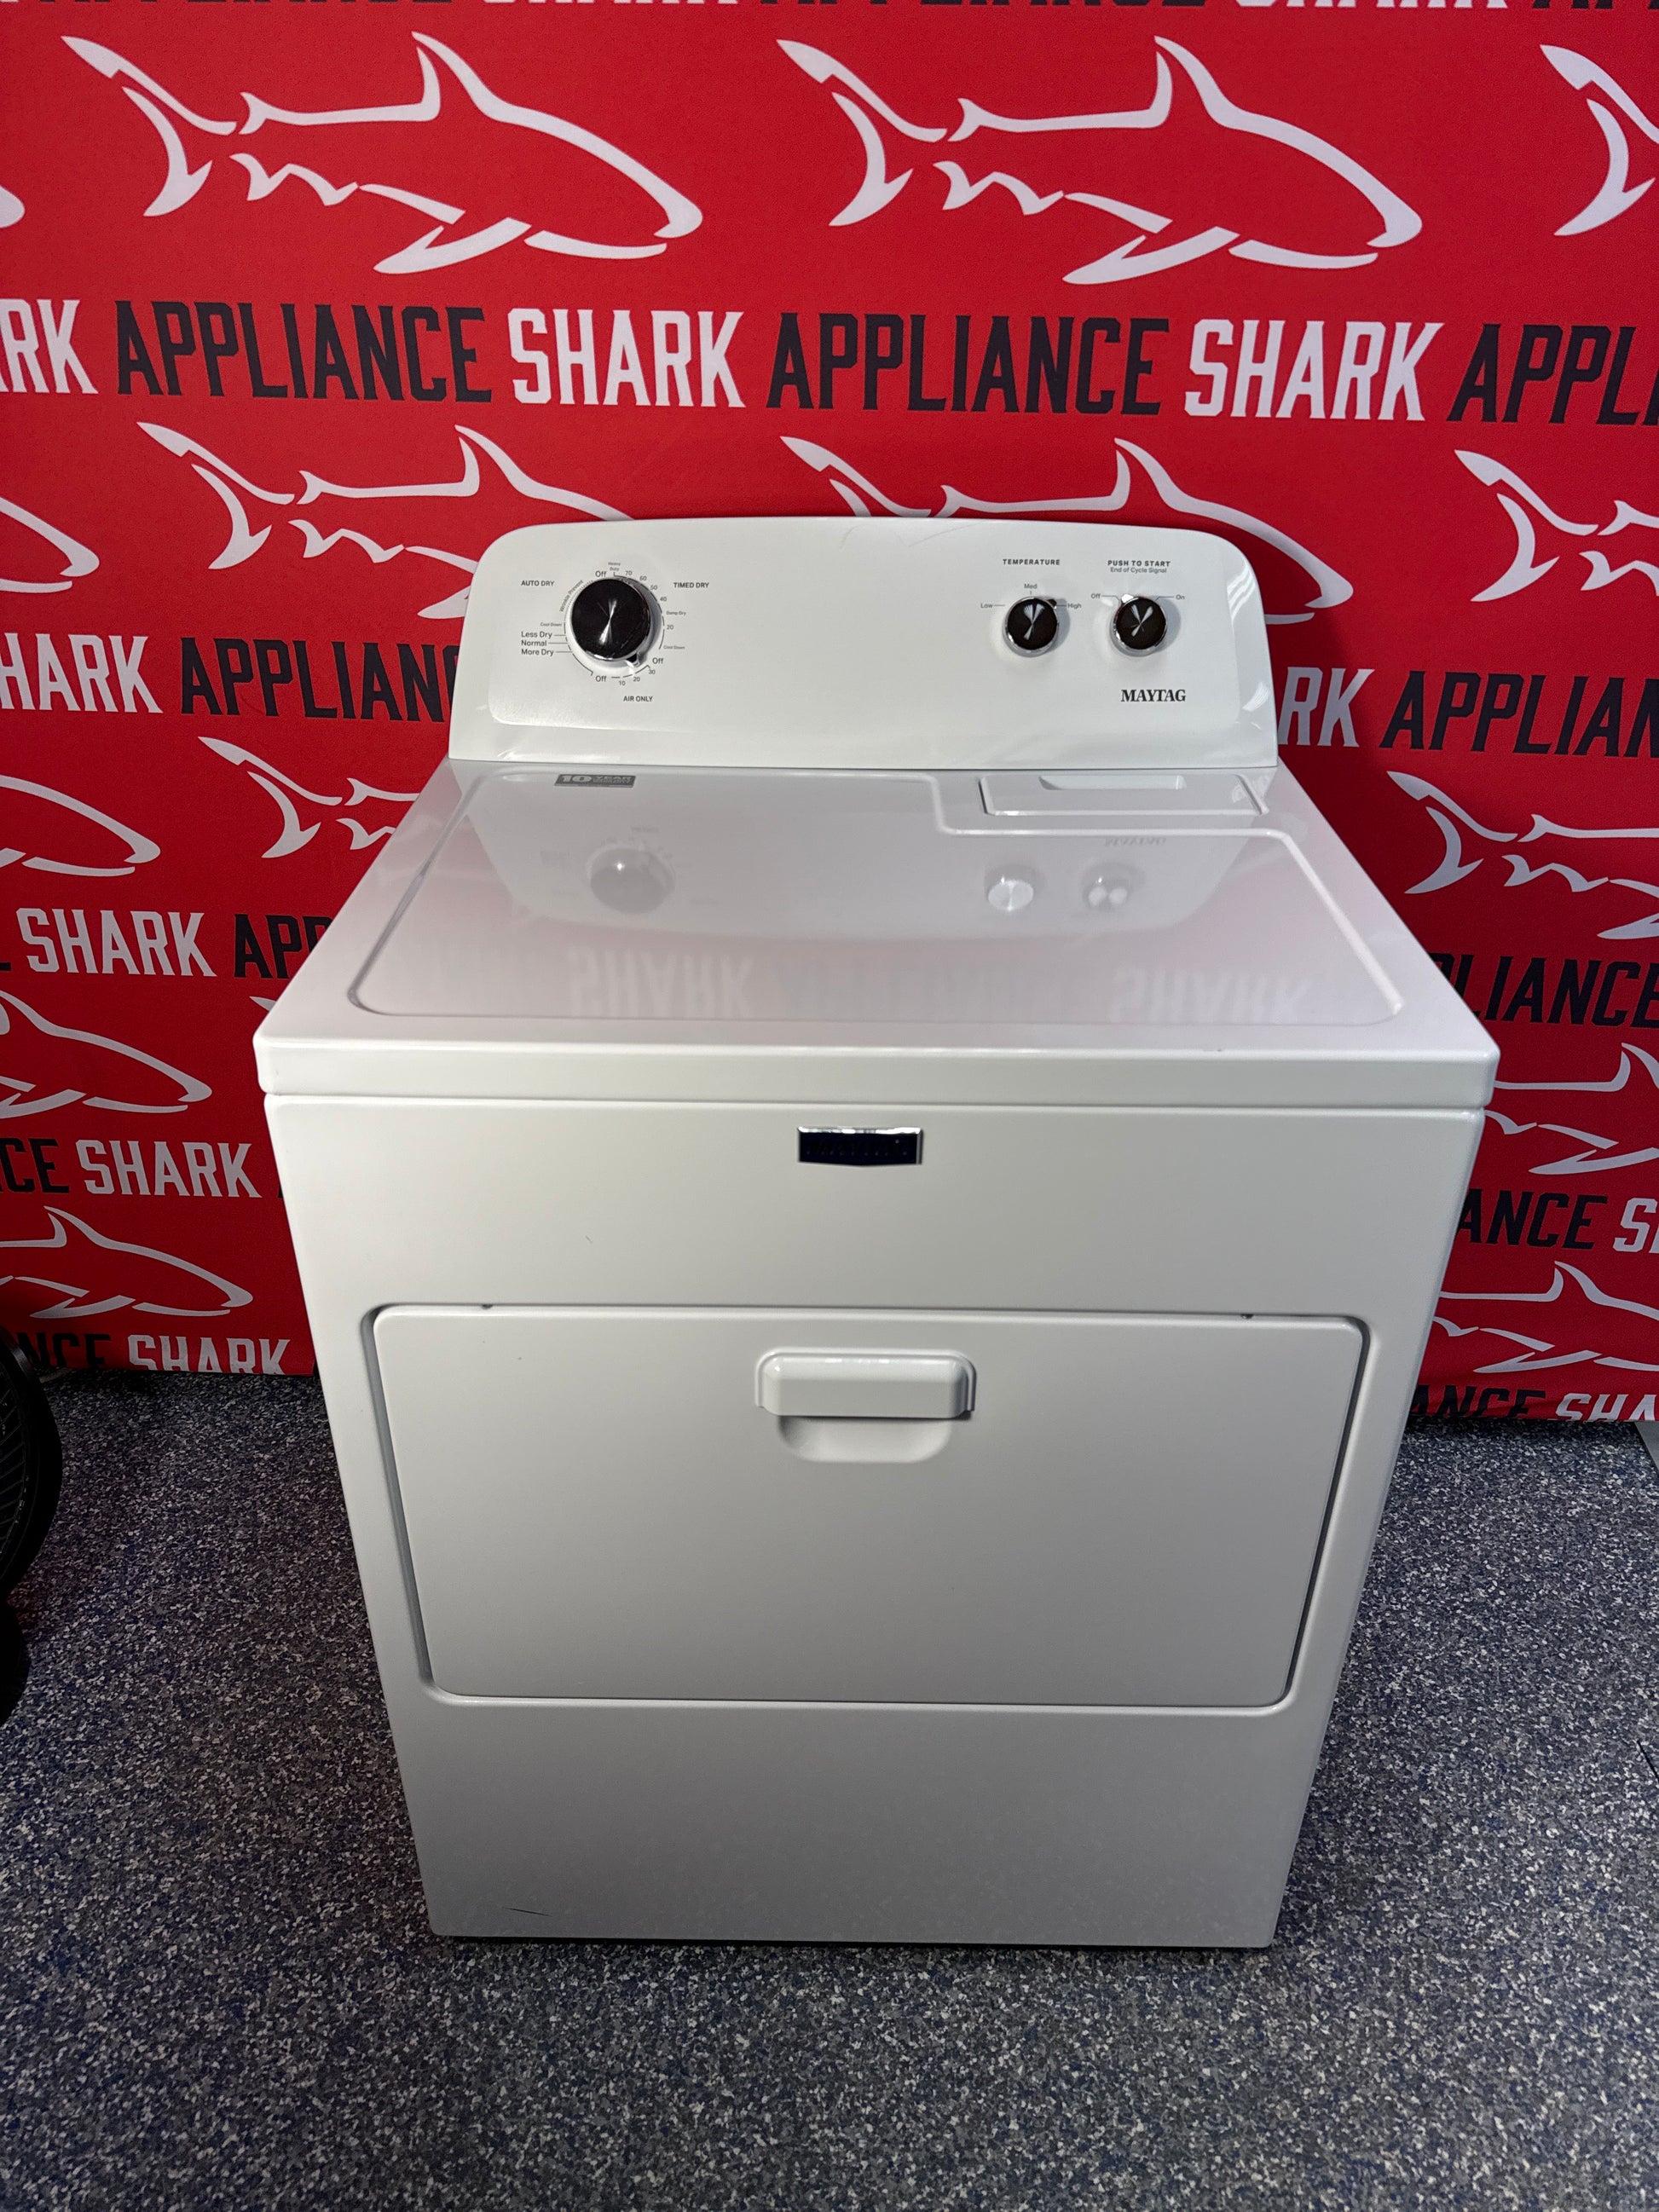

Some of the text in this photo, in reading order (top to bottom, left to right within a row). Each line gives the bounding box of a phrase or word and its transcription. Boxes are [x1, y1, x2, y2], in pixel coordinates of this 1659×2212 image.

[0, 298, 100, 394] RK
[114, 299, 493, 403] APPLIANCE
[507, 308, 748, 408] SHARK
[766, 312, 1170, 416] APPLIANCE
[1184, 318, 1443, 422] SHARK
[540, 631, 552, 639] Dry
[1120, 689, 1187, 702] MAYTAG
[16, 907, 217, 977] SHARK
[0, 1137, 263, 1198] CE SHARK
